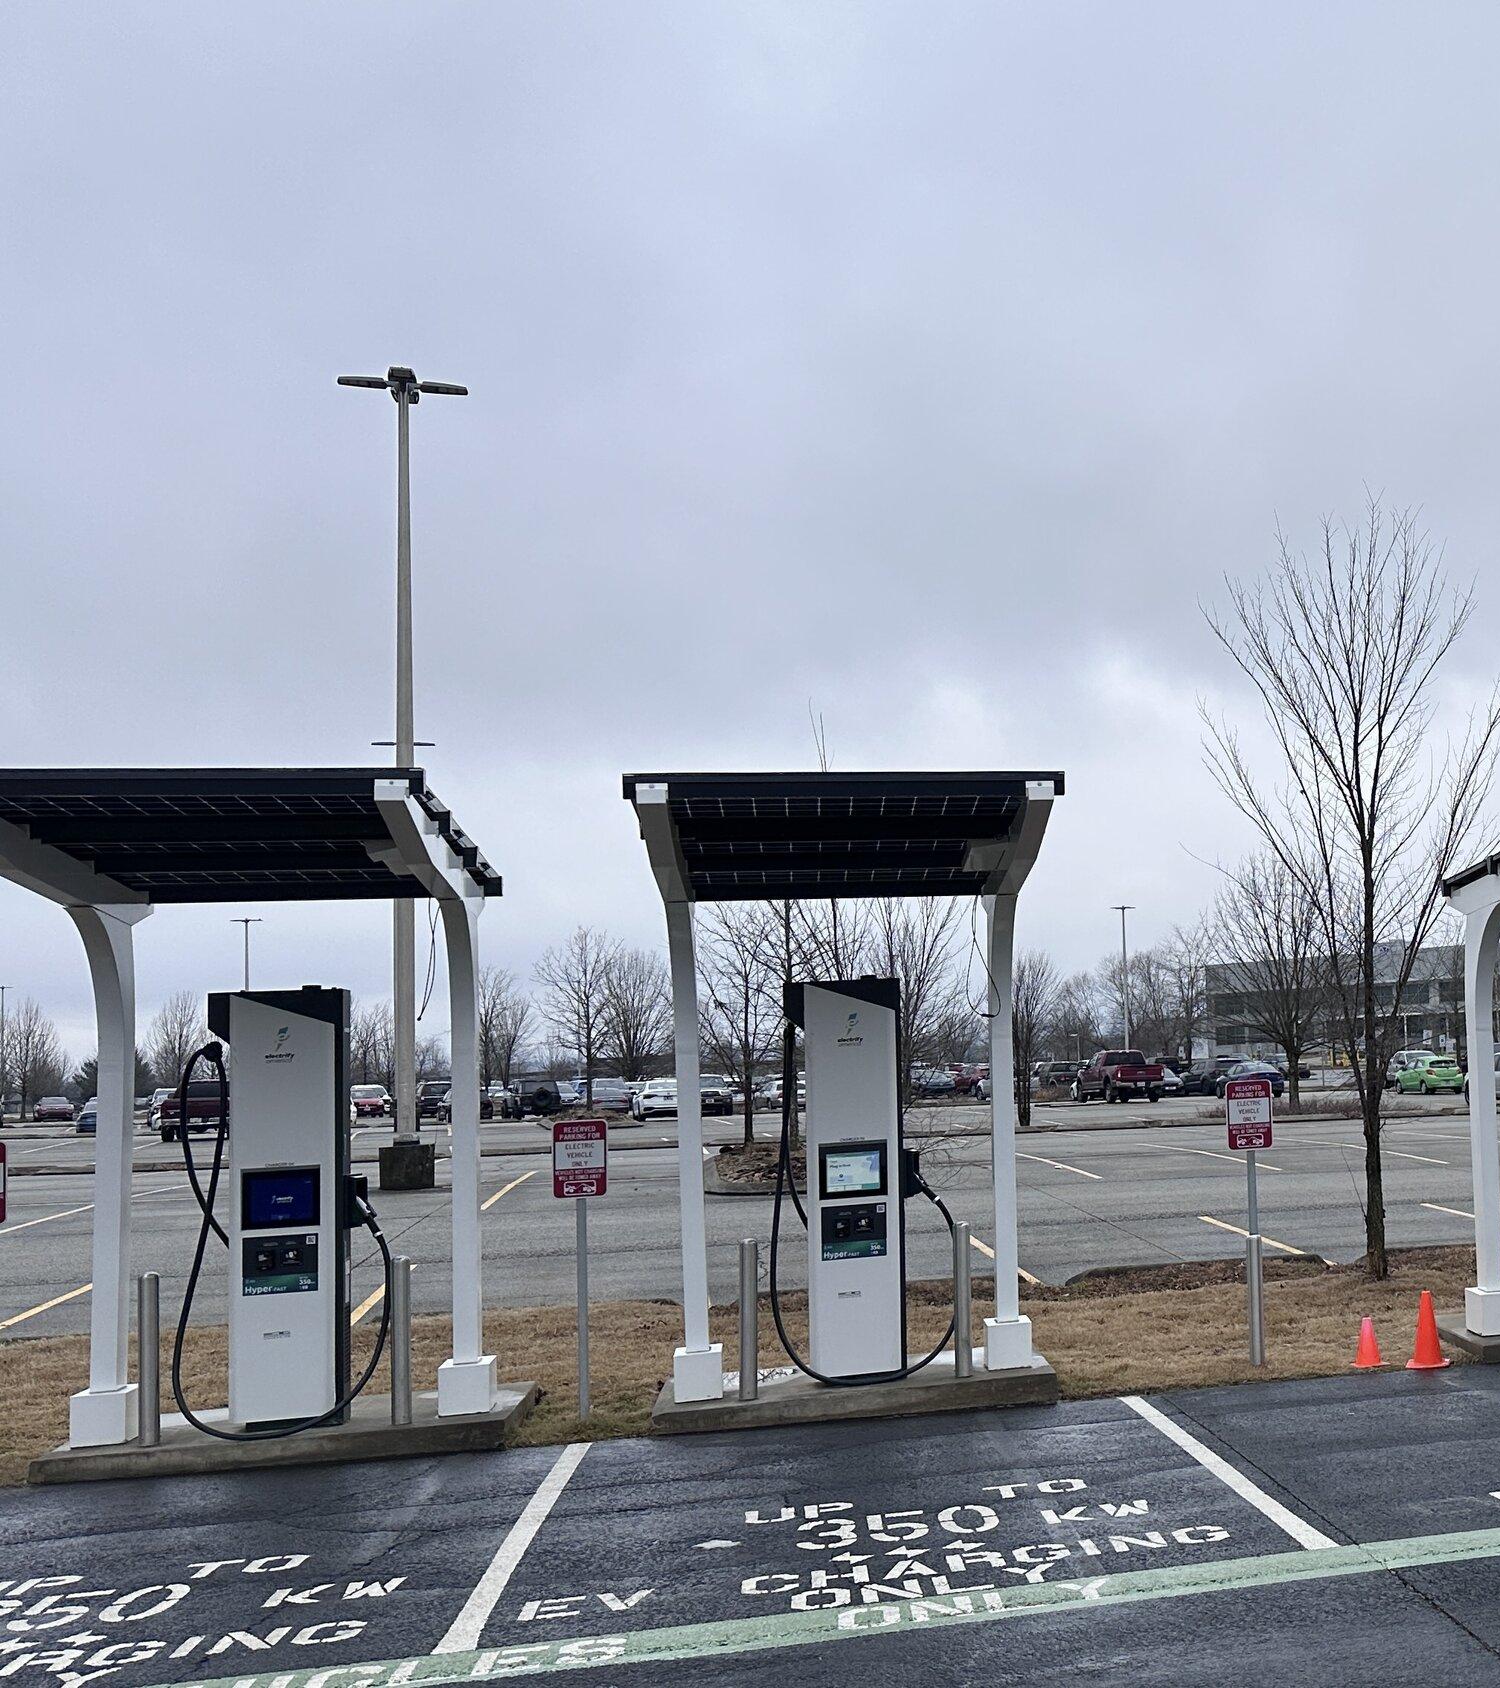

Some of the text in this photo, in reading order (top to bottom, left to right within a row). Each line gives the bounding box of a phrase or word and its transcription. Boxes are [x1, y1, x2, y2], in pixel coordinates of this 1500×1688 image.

[265, 1053, 295, 1061] electrify
[563, 1125, 596, 1133] RESERVED
[565, 1142, 595, 1150] ELECTRIC
[823, 1251, 848, 1259] Hyper
[244, 1286, 272, 1295] Hyper
[745, 1478, 1088, 1524] UP TO
[796, 1499, 1149, 1550] 350 KW
[0, 1554, 311, 1597] P TO
[517, 1525, 1231, 1622] EV CHARGING
[790, 1562, 1055, 1610] ONLY
[0, 1576, 408, 1632] 50 KW
[837, 1577, 1110, 1630] ONLY
